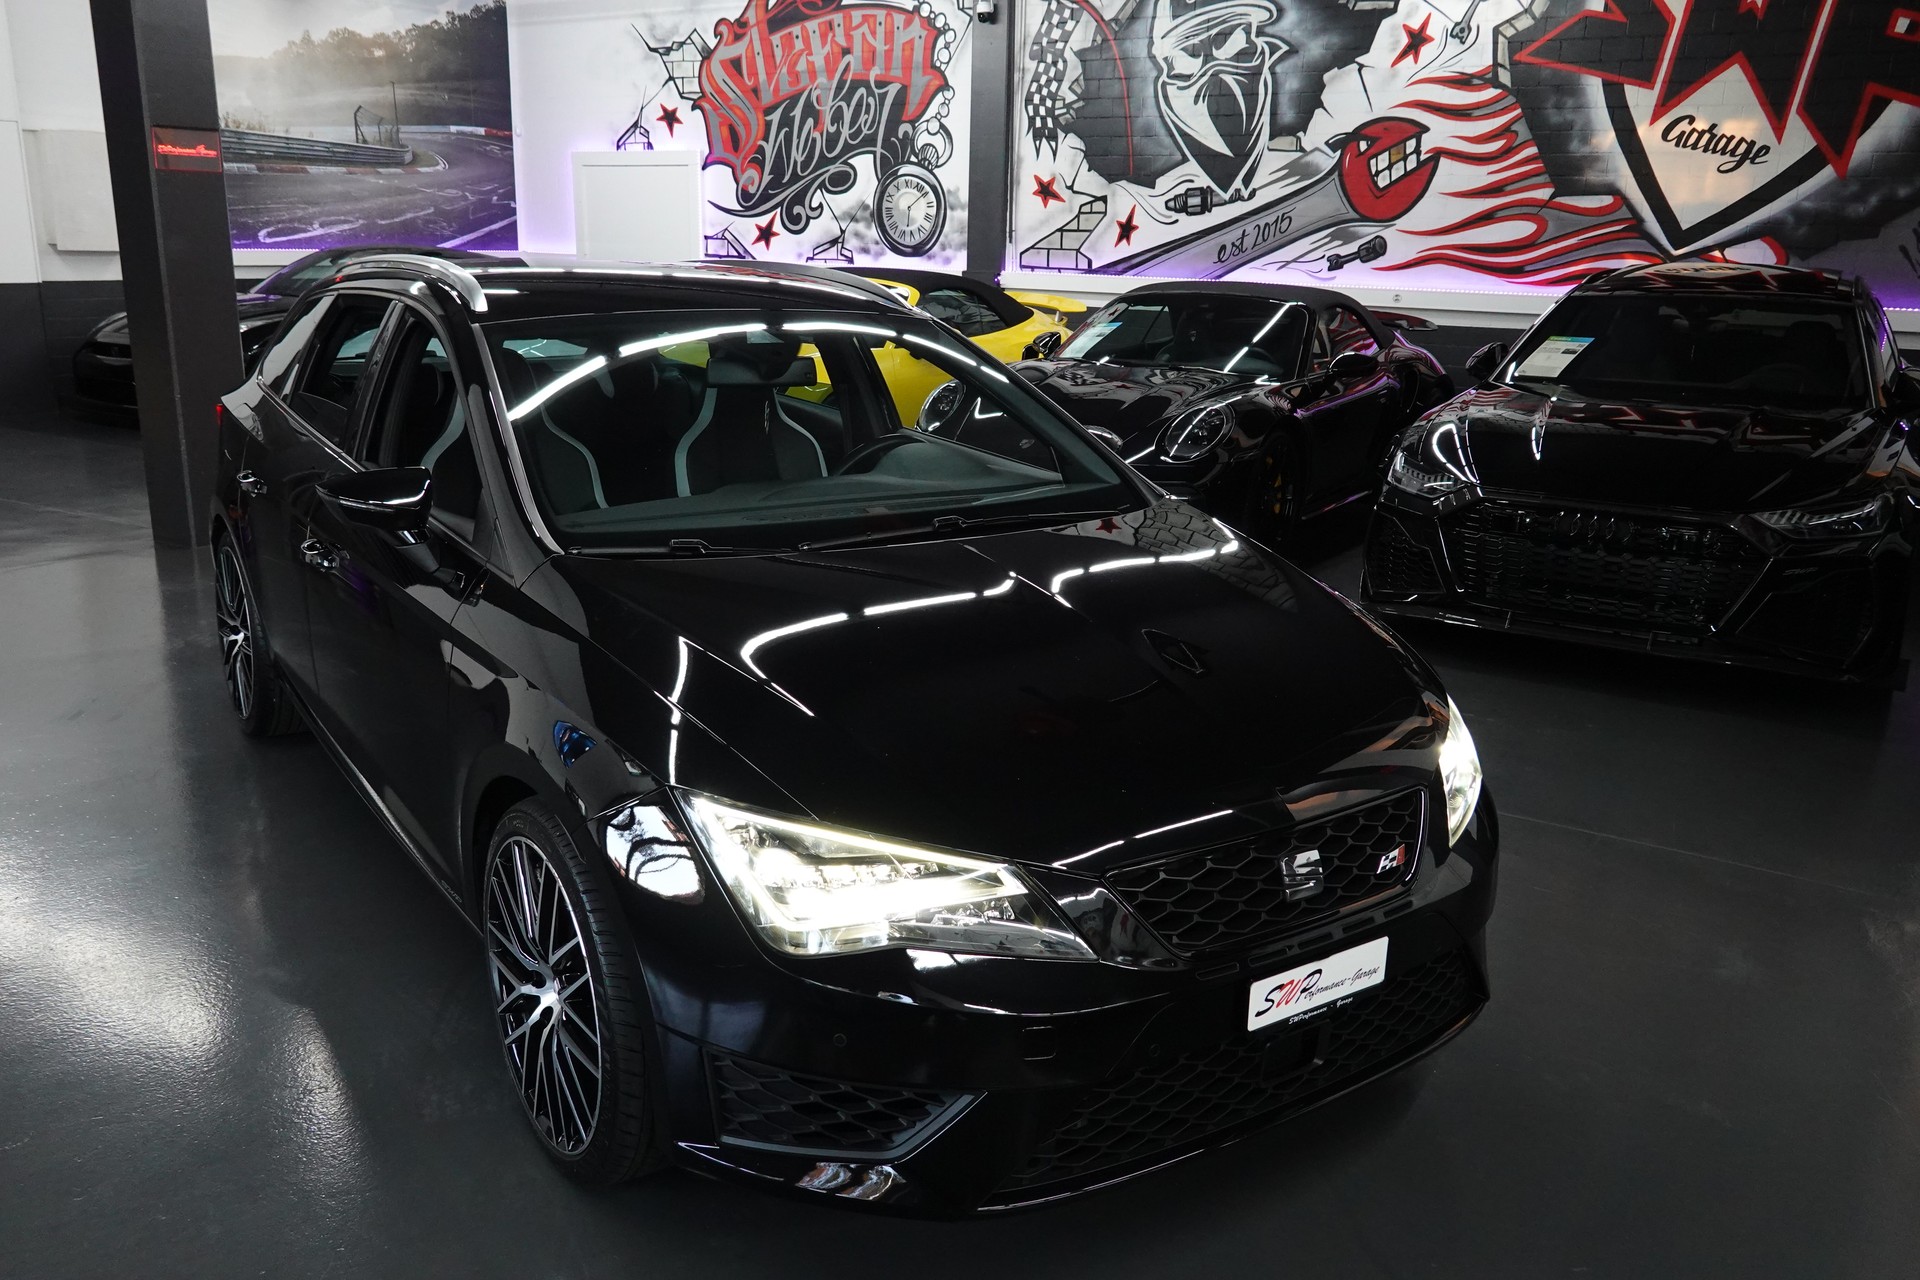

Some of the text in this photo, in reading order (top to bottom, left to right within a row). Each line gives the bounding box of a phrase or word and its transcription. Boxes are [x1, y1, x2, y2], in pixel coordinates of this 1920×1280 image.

[1661, 114, 1771, 174] Garage
[1213, 207, 1296, 264] est 2015
